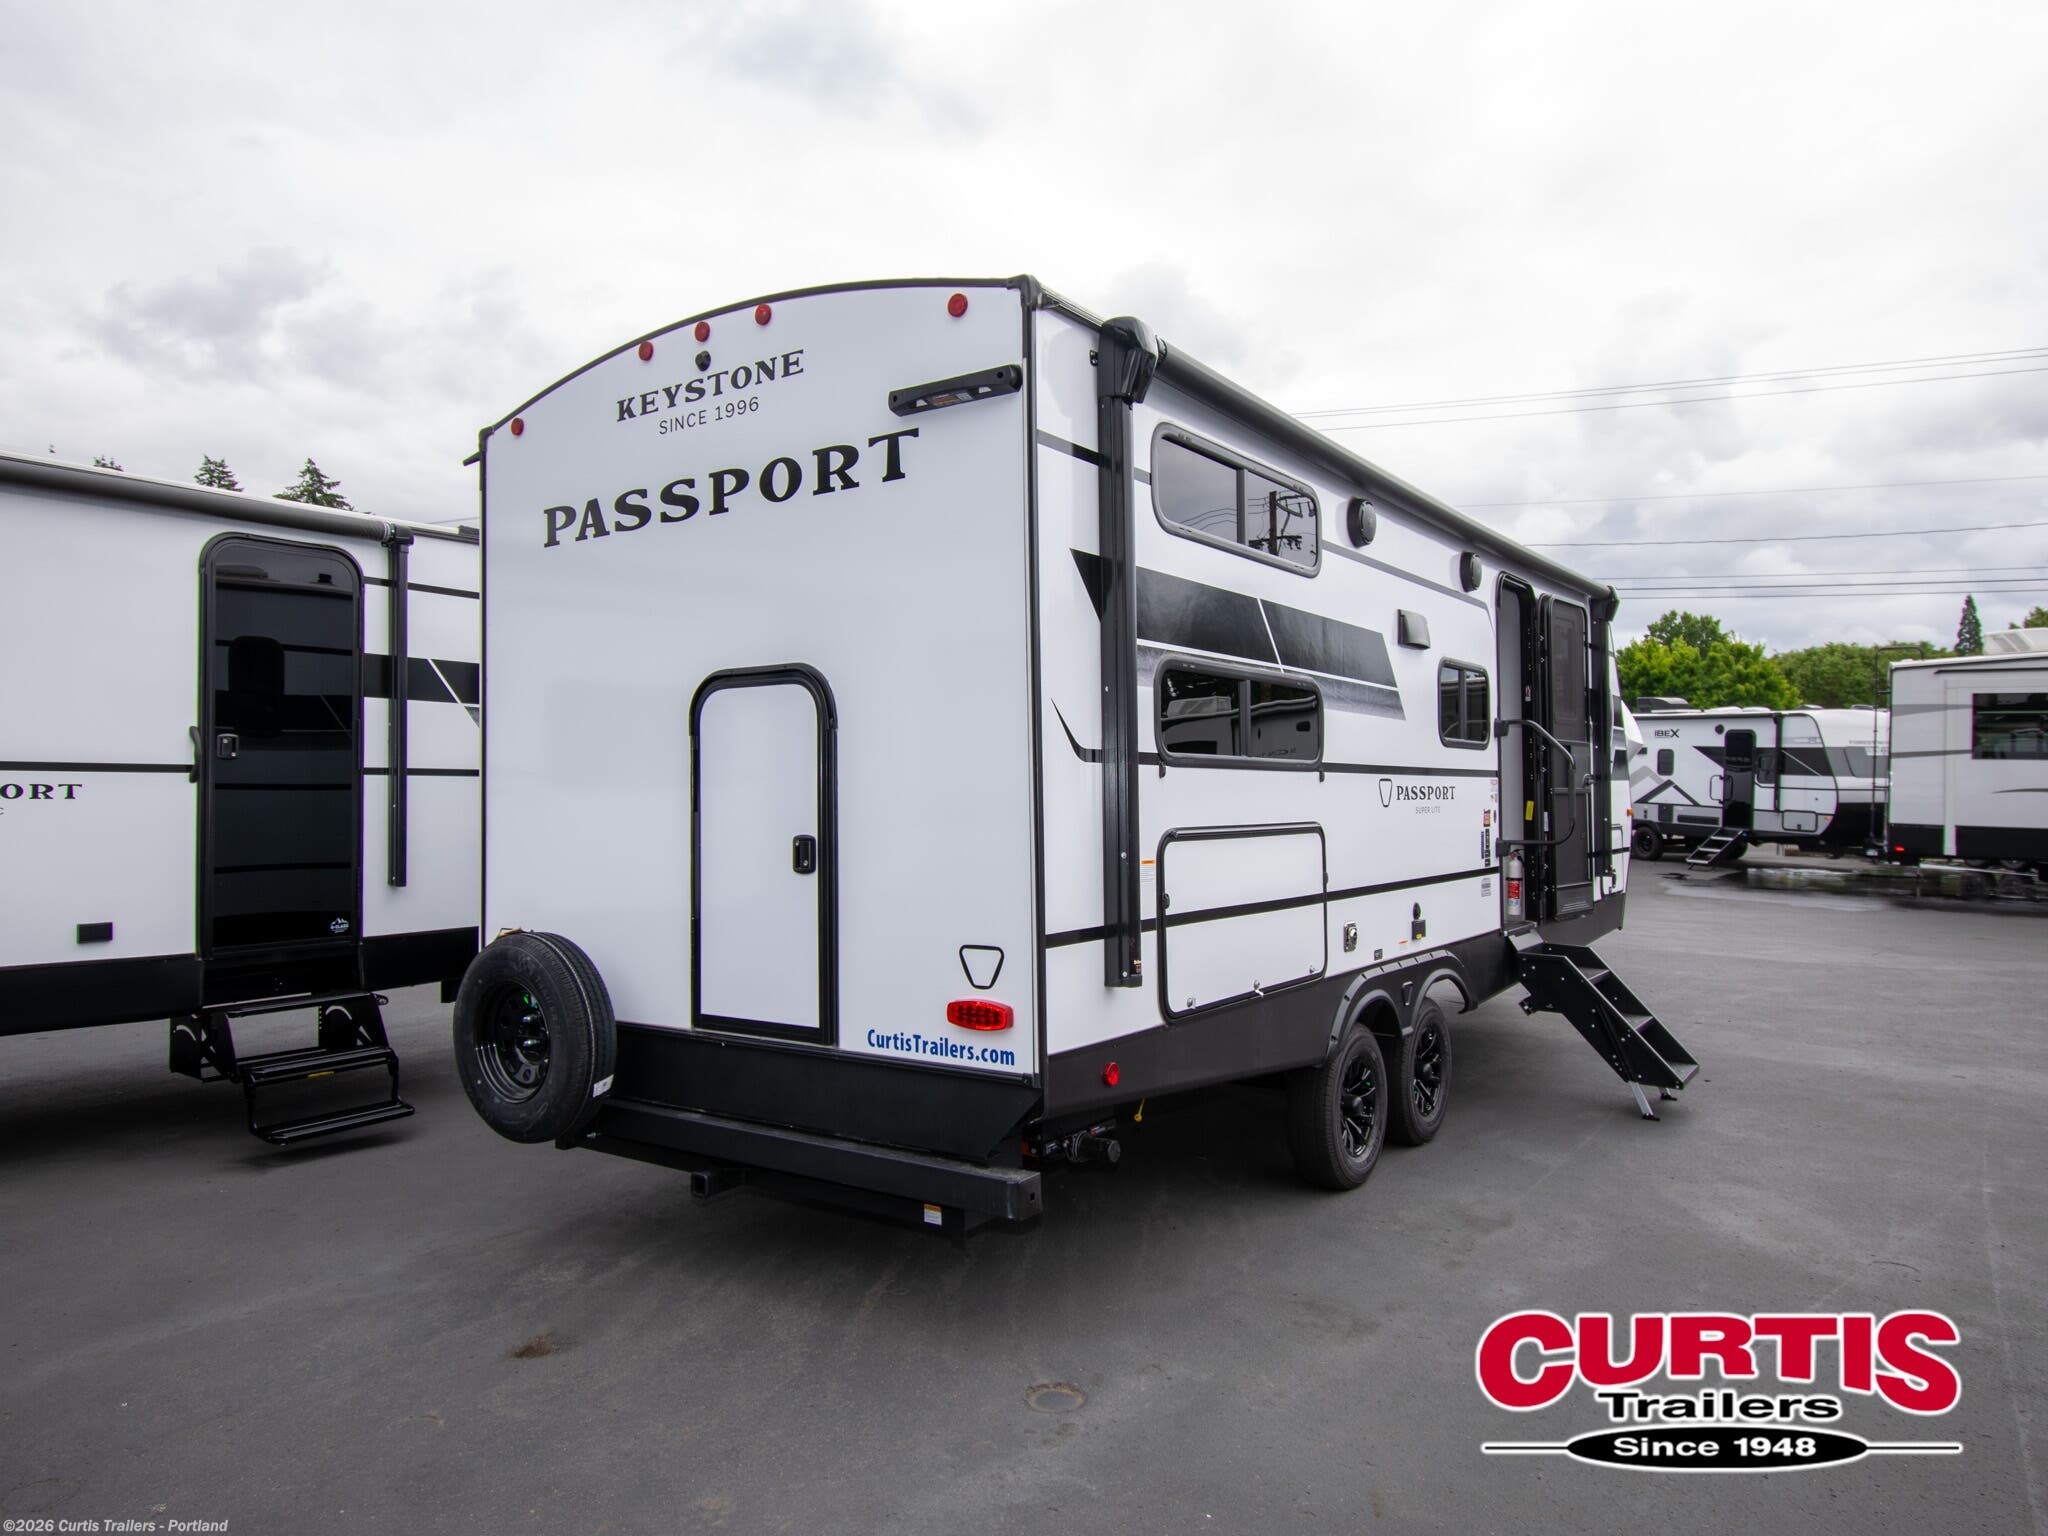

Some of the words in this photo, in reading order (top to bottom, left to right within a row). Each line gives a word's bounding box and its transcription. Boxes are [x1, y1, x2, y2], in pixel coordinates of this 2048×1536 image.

[617, 349, 804, 422] KEYSTONE
[659, 410, 707, 435] SINCE
[715, 396, 759, 421] 1996
[543, 427, 919, 548] PASSPORT
[1396, 785, 1456, 801] PASSPORT
[867, 1029, 1015, 1066] CurtisTrailers.com
